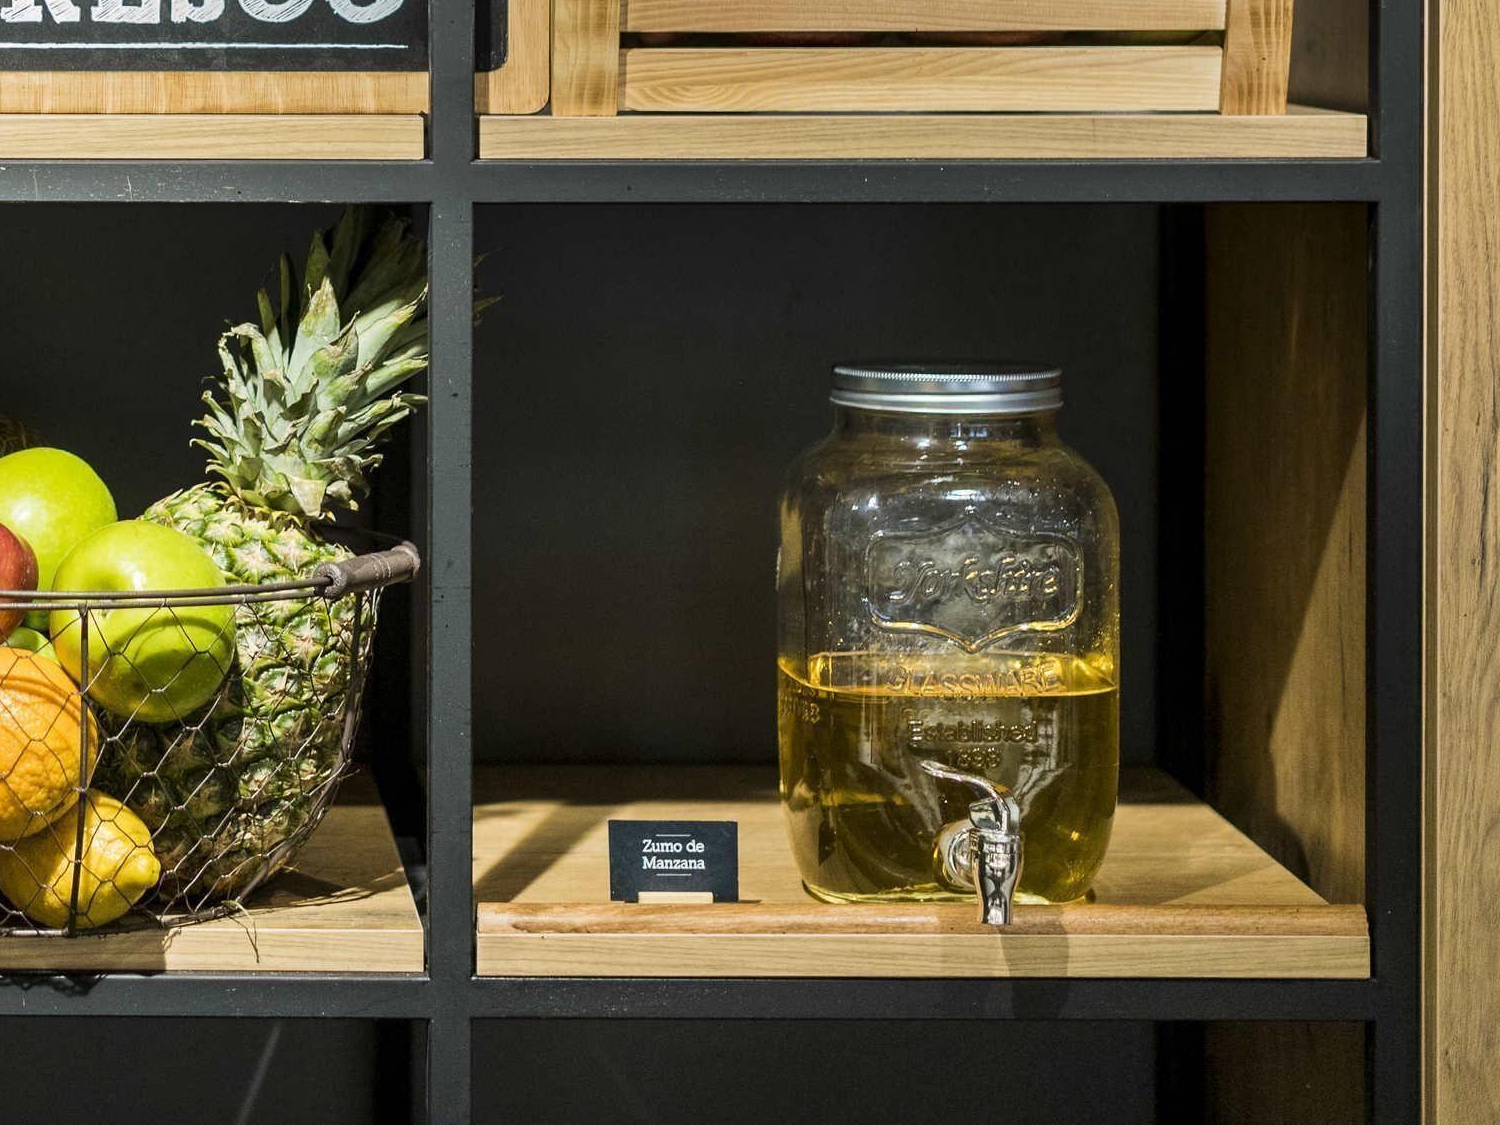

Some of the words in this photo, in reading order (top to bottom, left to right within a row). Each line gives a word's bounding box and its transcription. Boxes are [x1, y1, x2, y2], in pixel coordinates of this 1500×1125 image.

[885, 662, 1063, 696] GLASSWARE
[908, 720, 1038, 743] Established
[642, 839, 683, 853] Zumo
[685, 839, 706, 853] de
[642, 856, 706, 870] Manzana
